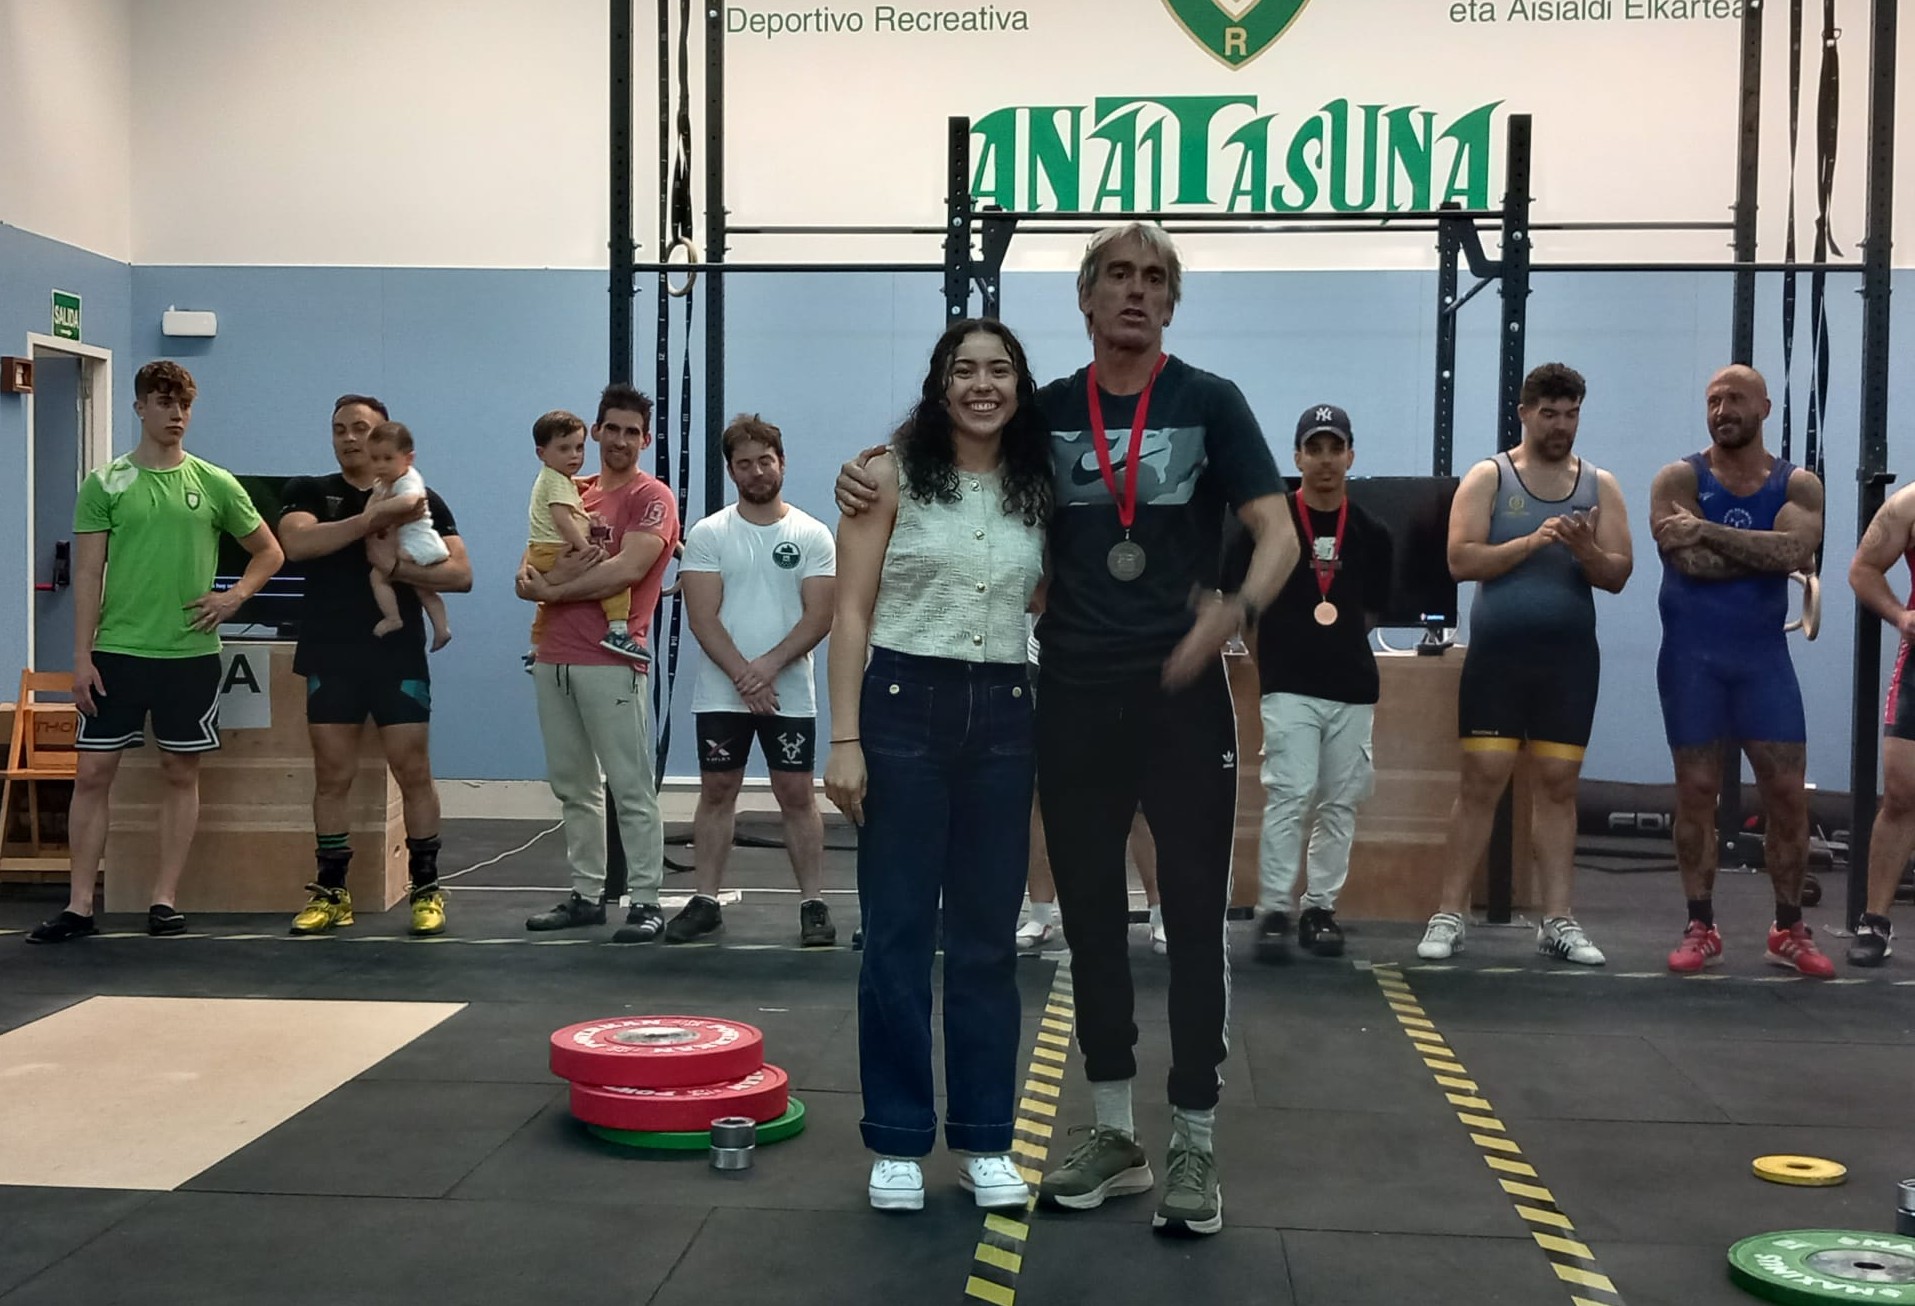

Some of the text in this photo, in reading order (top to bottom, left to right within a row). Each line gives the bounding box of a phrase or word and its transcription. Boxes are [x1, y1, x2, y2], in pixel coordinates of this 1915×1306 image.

[726, 5, 1029, 39] Deportivo Recreativa
[1449, 0, 1496, 22] eta
[1224, 26, 1248, 56] R
[54, 304, 80, 329] SALIDA
[220, 653, 261, 694] A
